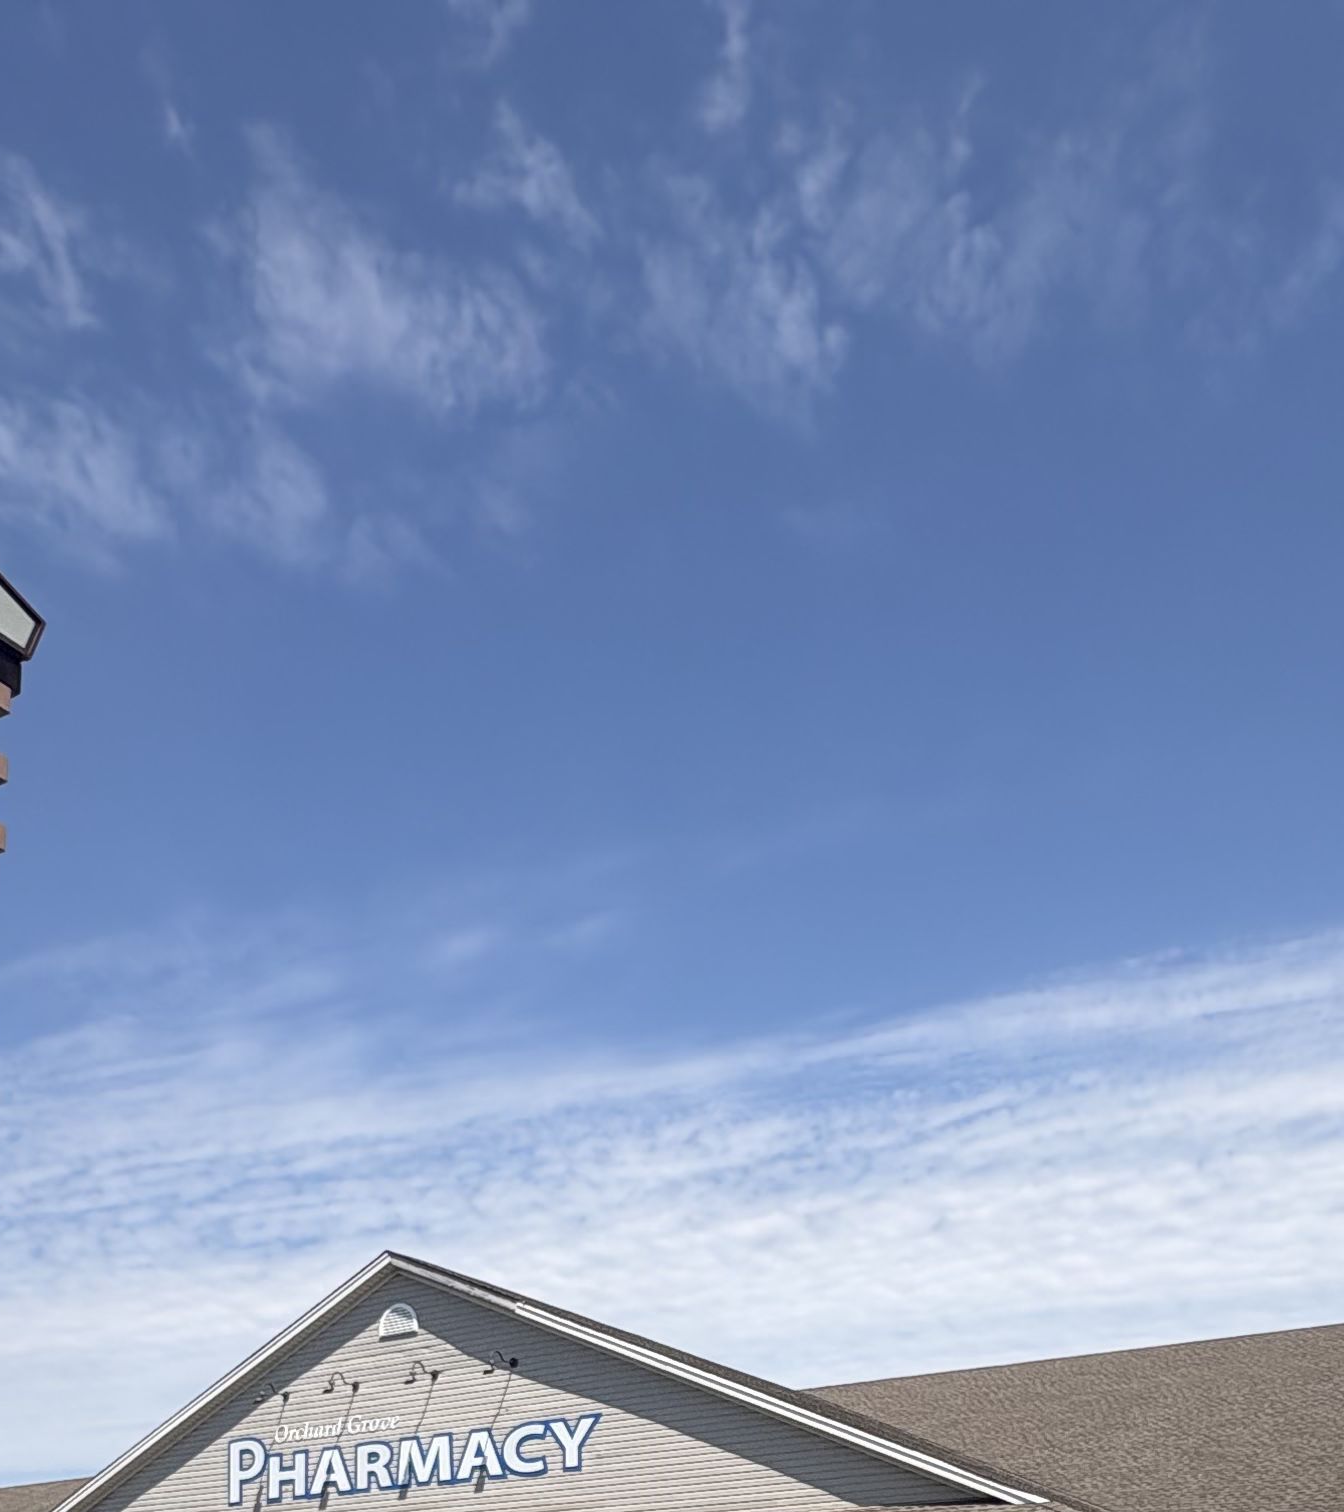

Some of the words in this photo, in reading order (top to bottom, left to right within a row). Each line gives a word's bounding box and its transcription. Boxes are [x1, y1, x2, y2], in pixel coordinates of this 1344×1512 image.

[228, 1412, 603, 1507] PHARMACY
[274, 1418, 343, 1443] Orchard
[346, 1414, 400, 1434] Grove
